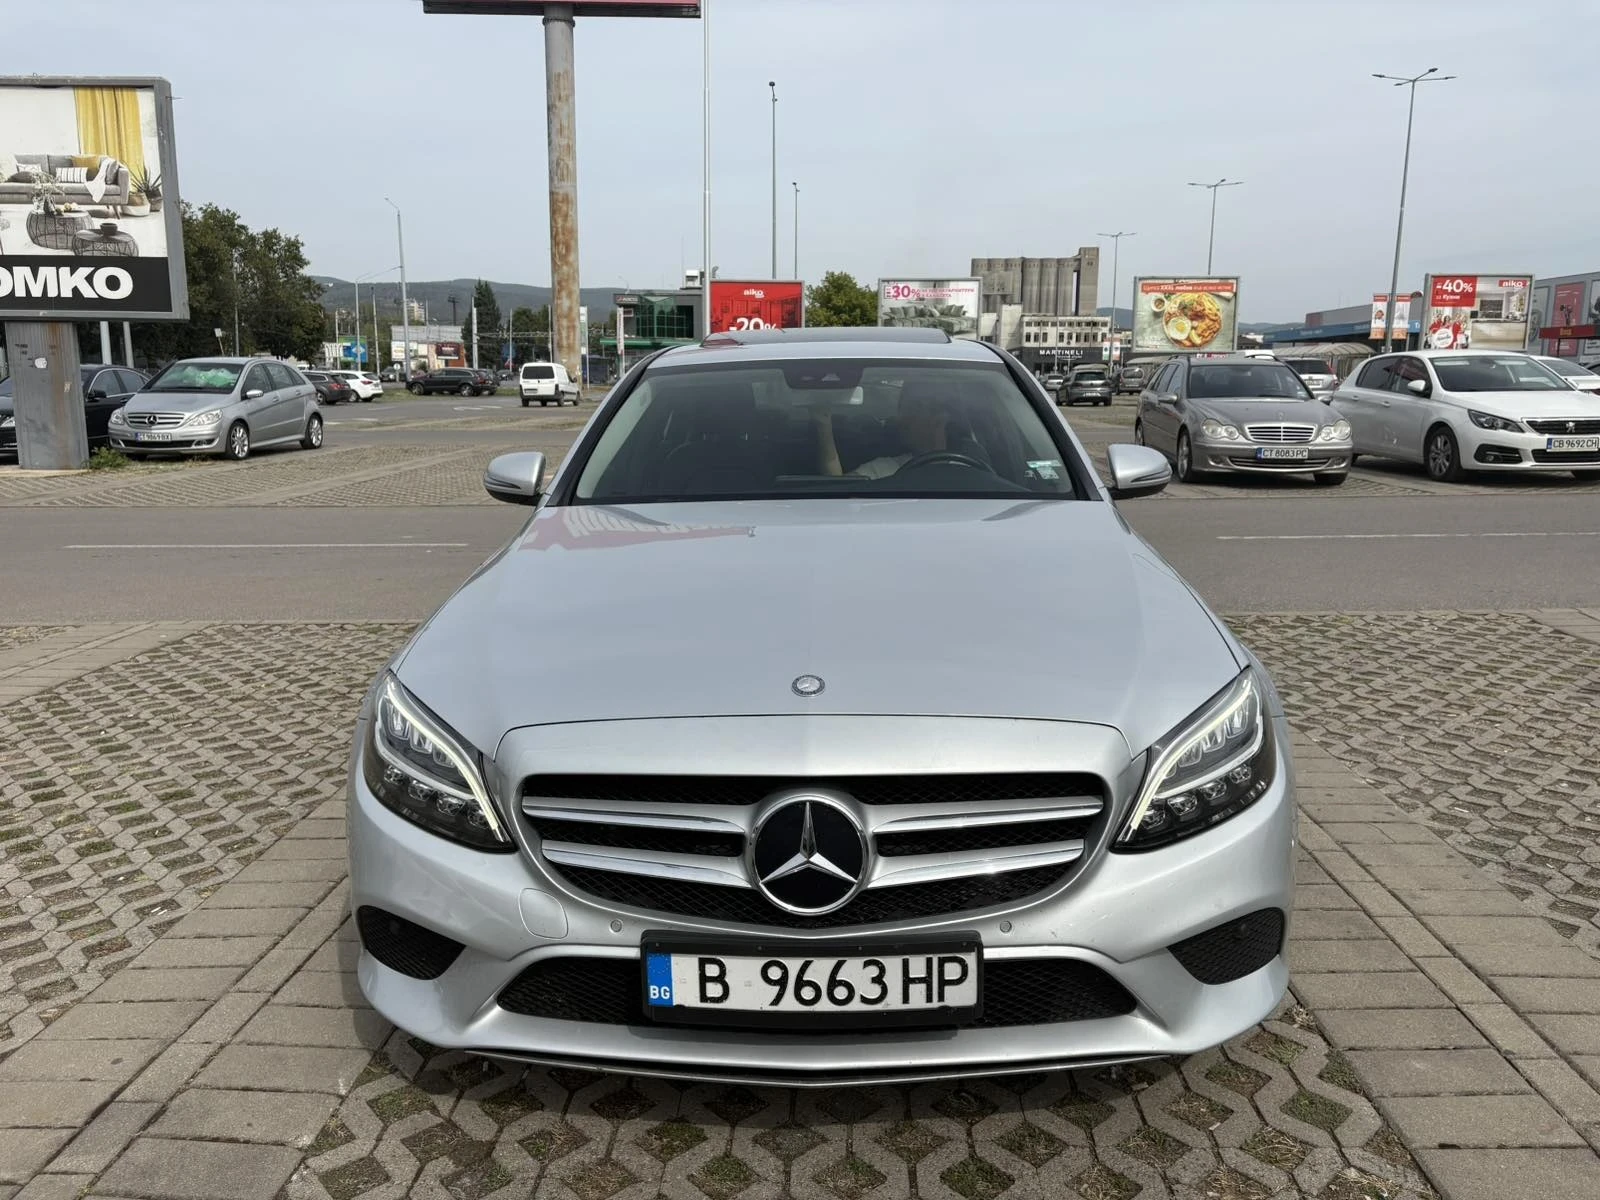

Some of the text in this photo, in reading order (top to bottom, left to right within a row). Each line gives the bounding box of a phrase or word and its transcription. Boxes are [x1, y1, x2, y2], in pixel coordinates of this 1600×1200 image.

[1436, 279, 1473, 293] -40%
[697, 955, 970, 1006] B 9663 HP
[649, 985, 670, 999] BG
